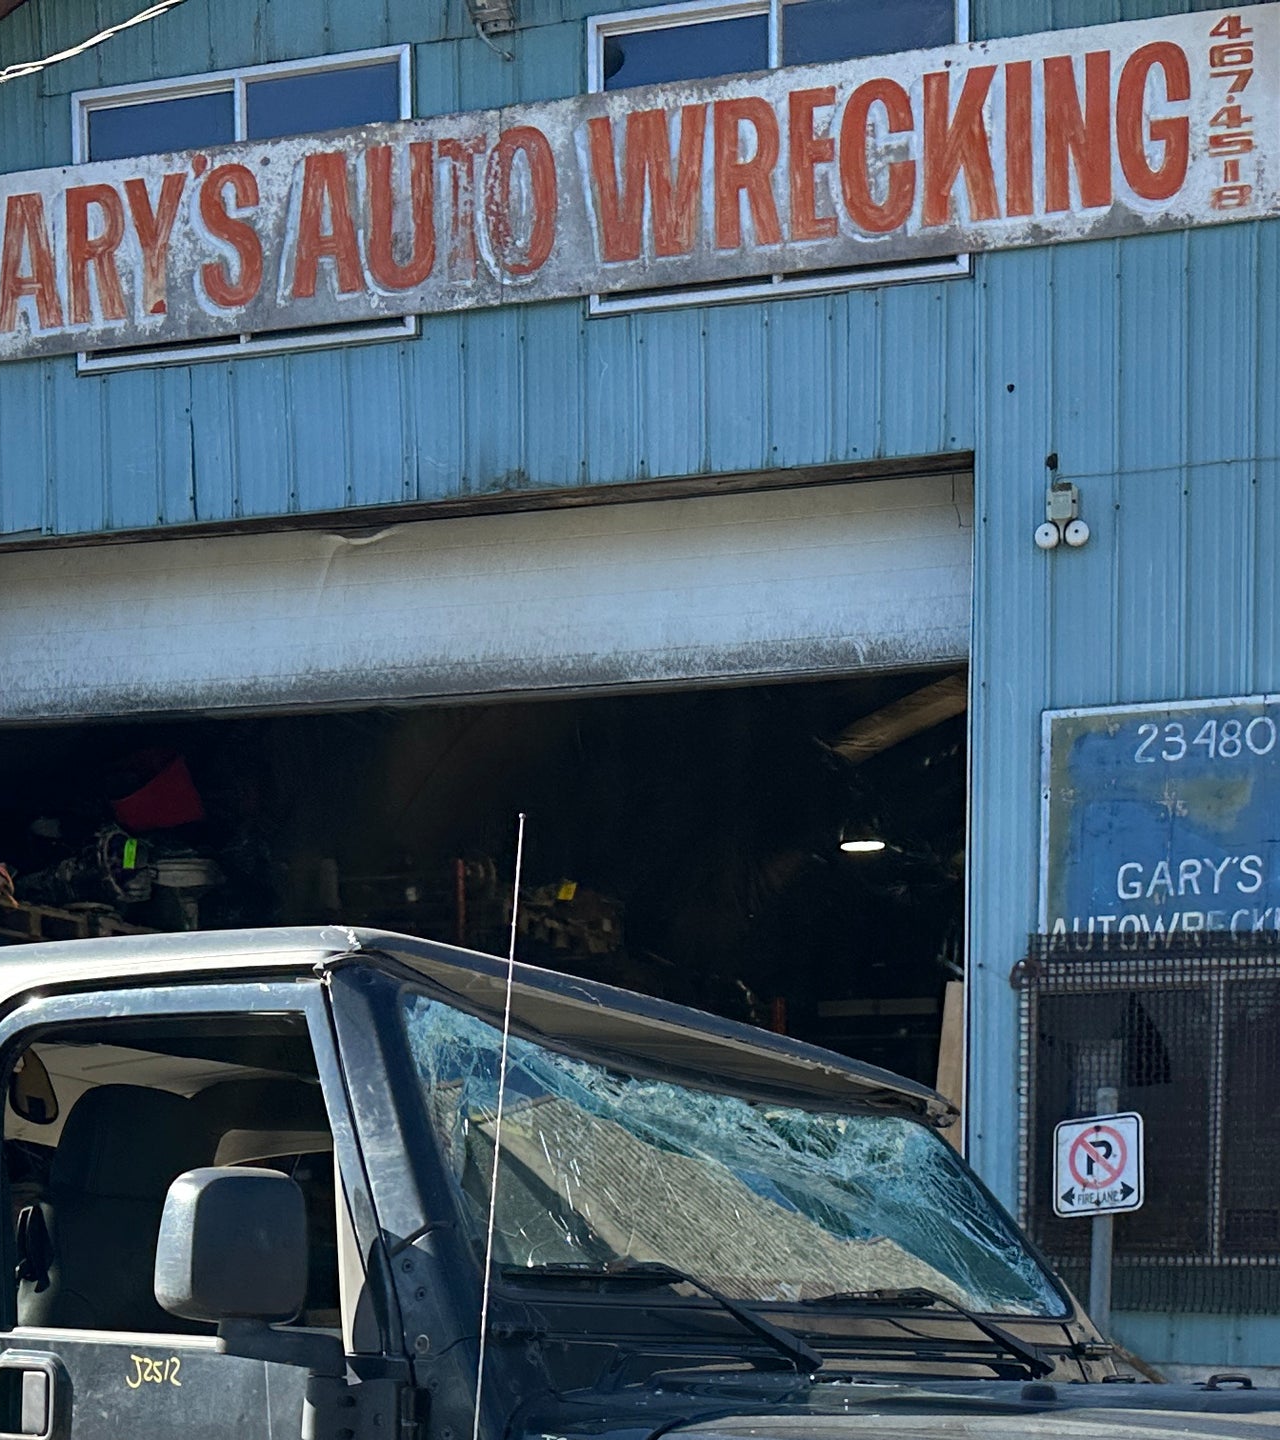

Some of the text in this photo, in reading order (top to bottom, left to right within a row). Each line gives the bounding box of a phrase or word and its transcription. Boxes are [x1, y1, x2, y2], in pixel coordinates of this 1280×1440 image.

[290, 125, 558, 300] AUTO
[586, 40, 1193, 262] WRECKING
[1134, 716, 1277, 764] 23480
[1116, 855, 1264, 900] GARY'S
[1077, 1193, 1095, 1206] FIRE
[125, 1353, 182, 1389] J2512
